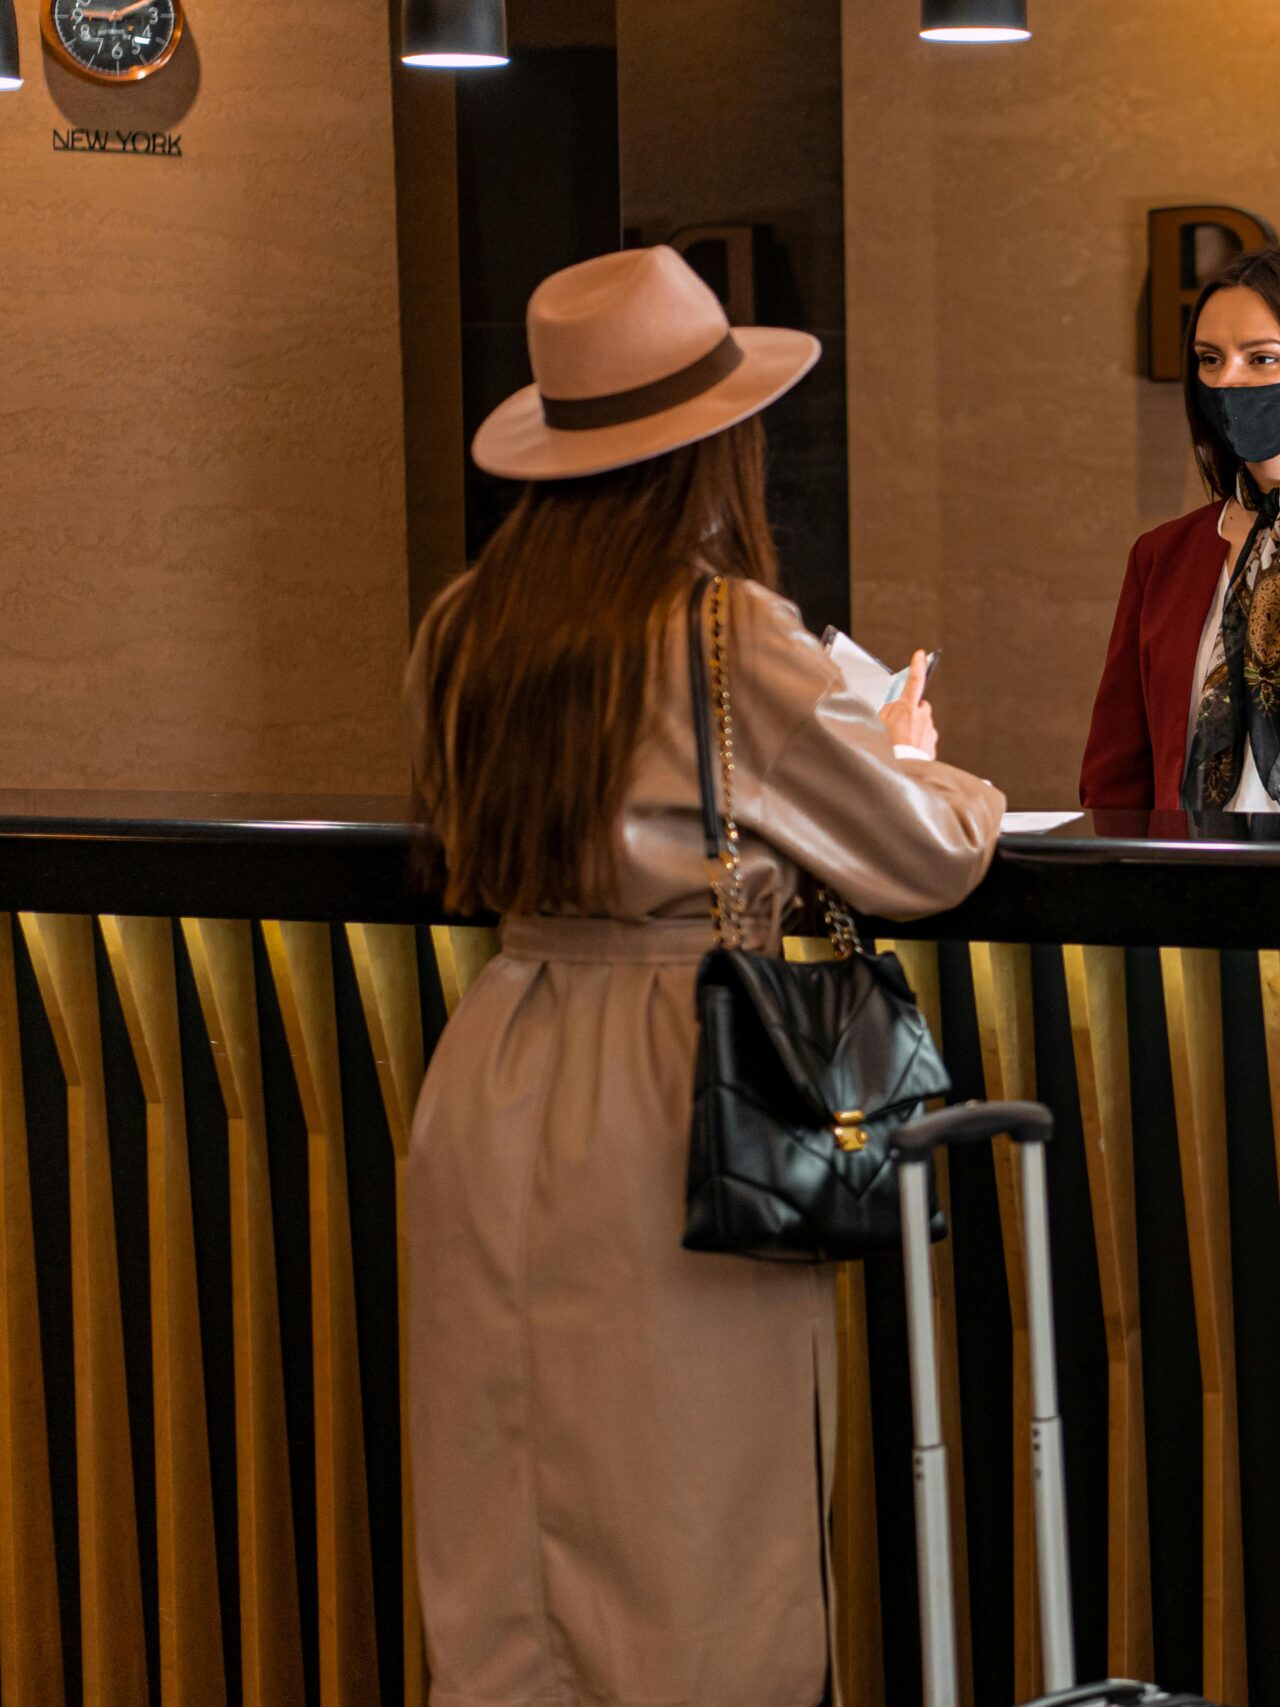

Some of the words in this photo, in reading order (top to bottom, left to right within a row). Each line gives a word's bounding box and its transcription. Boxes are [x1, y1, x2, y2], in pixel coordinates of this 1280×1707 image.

[148, 6, 159, 25] 3
[111, 42, 123, 59] 6
[53, 128, 109, 151] NEW
[116, 131, 182, 156] YORK
